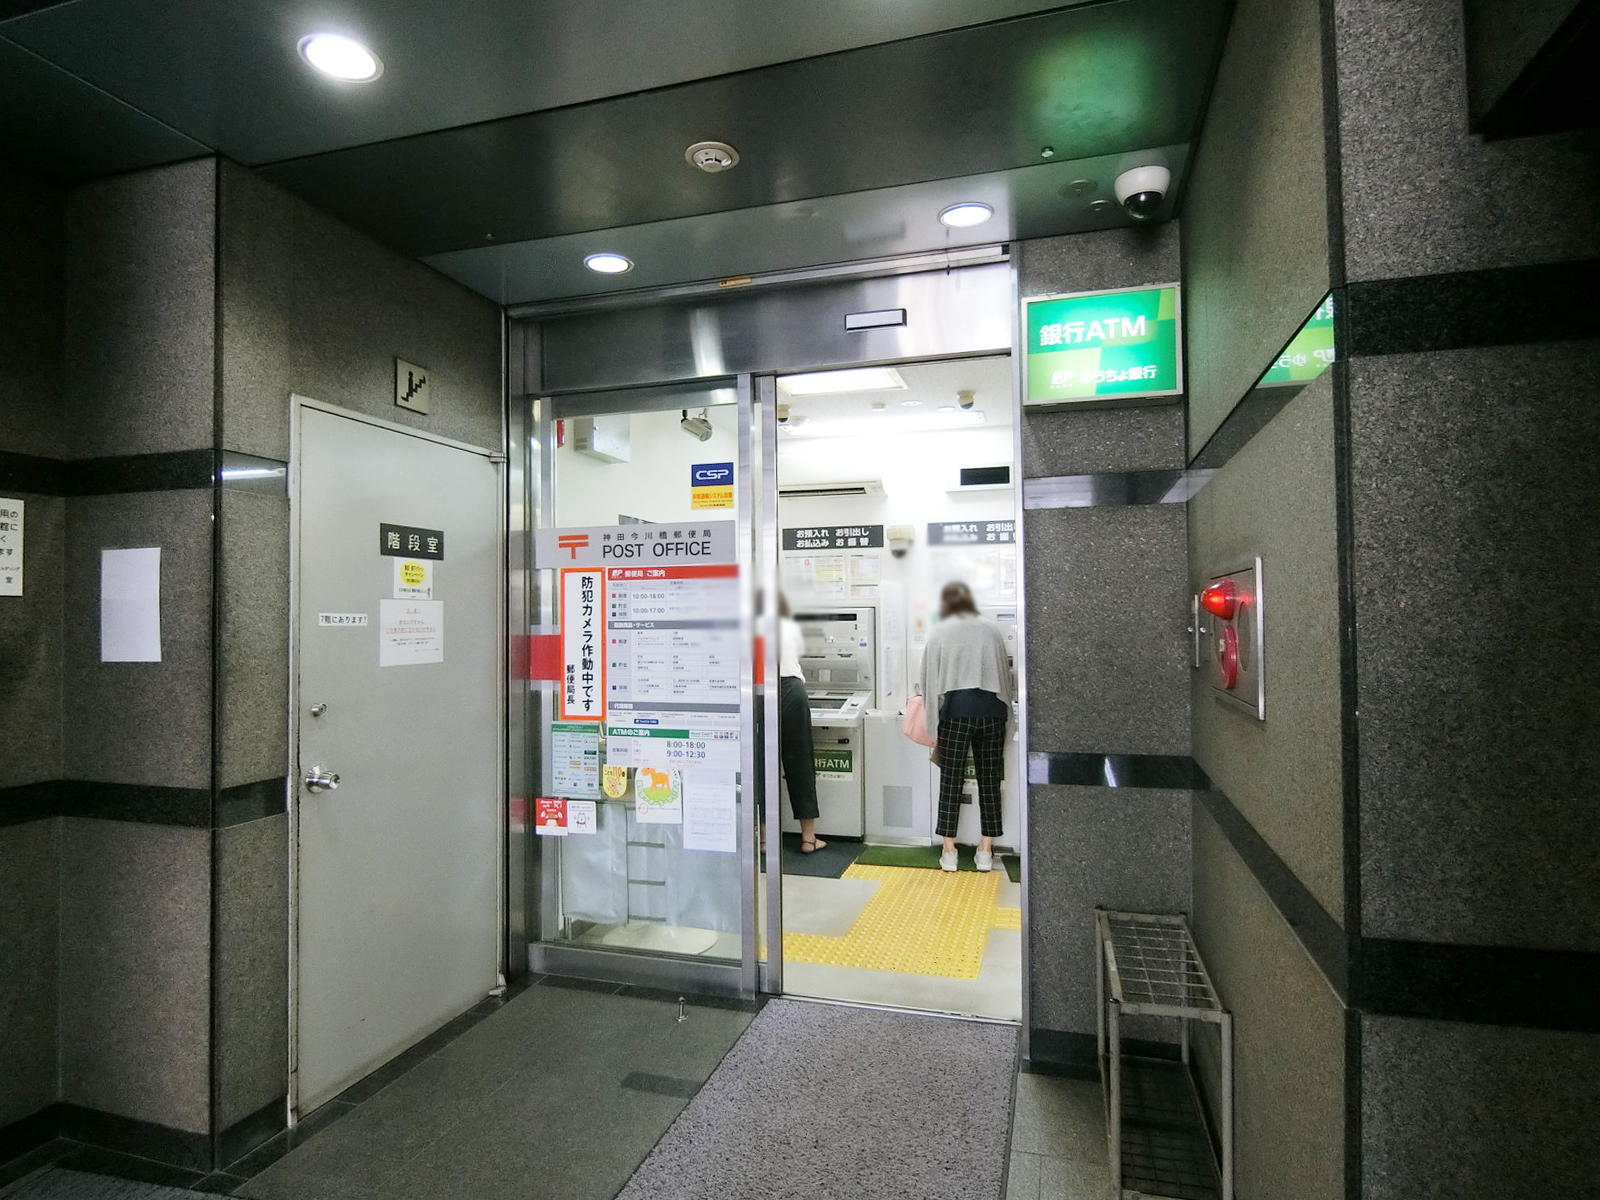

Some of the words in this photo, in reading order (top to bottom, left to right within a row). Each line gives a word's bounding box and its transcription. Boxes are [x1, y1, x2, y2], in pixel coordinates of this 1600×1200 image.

[1040, 316, 1146, 346] 銀行ATM
[1079, 365, 1157, 384] ゆうちょ銀行
[696, 469, 729, 480] CSP
[796, 529, 829, 538] お預入れ
[836, 528, 869, 537] お引出し
[986, 522, 1015, 532] お引出
[603, 529, 712, 542] 神田今川橋郵便局
[388, 531, 439, 553] 階段室
[796, 539, 829, 548] お払込み
[602, 543, 644, 559] POST
[652, 541, 712, 557] OFFICE
[646, 569, 666, 577] ご案内
[581, 576, 594, 712] 防犯カメラ作動中です
[566, 664, 576, 705] 郵便局長
[666, 741, 706, 749] 8:00-18:00
[666, 750, 706, 758] 9:00-12:30
